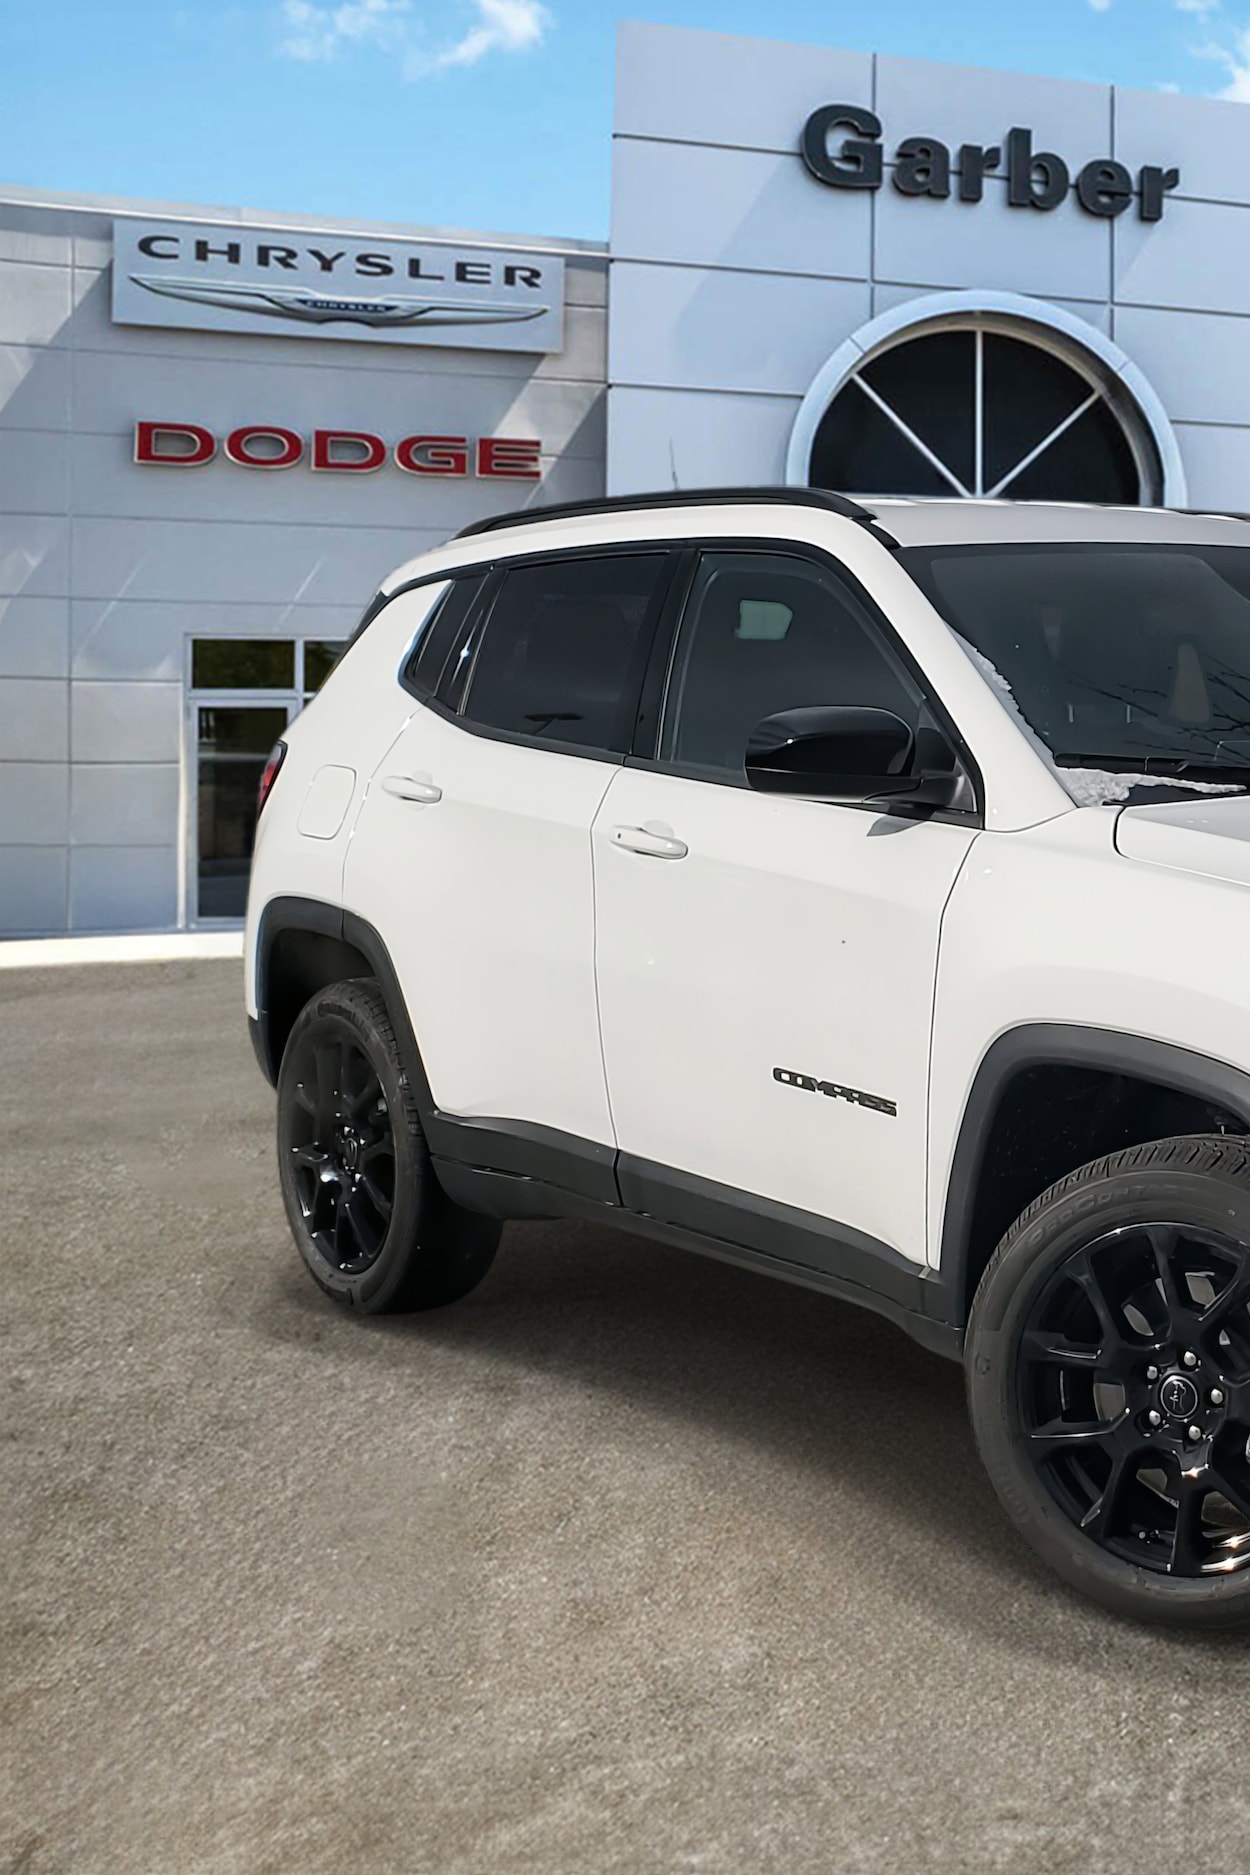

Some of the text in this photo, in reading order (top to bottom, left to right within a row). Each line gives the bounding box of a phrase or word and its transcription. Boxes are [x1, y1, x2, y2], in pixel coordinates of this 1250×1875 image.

[803, 104, 1180, 222] Garber
[137, 235, 542, 288] CHRYSLER
[134, 421, 542, 479] DODGE
[773, 1067, 897, 1117] COMPASS
